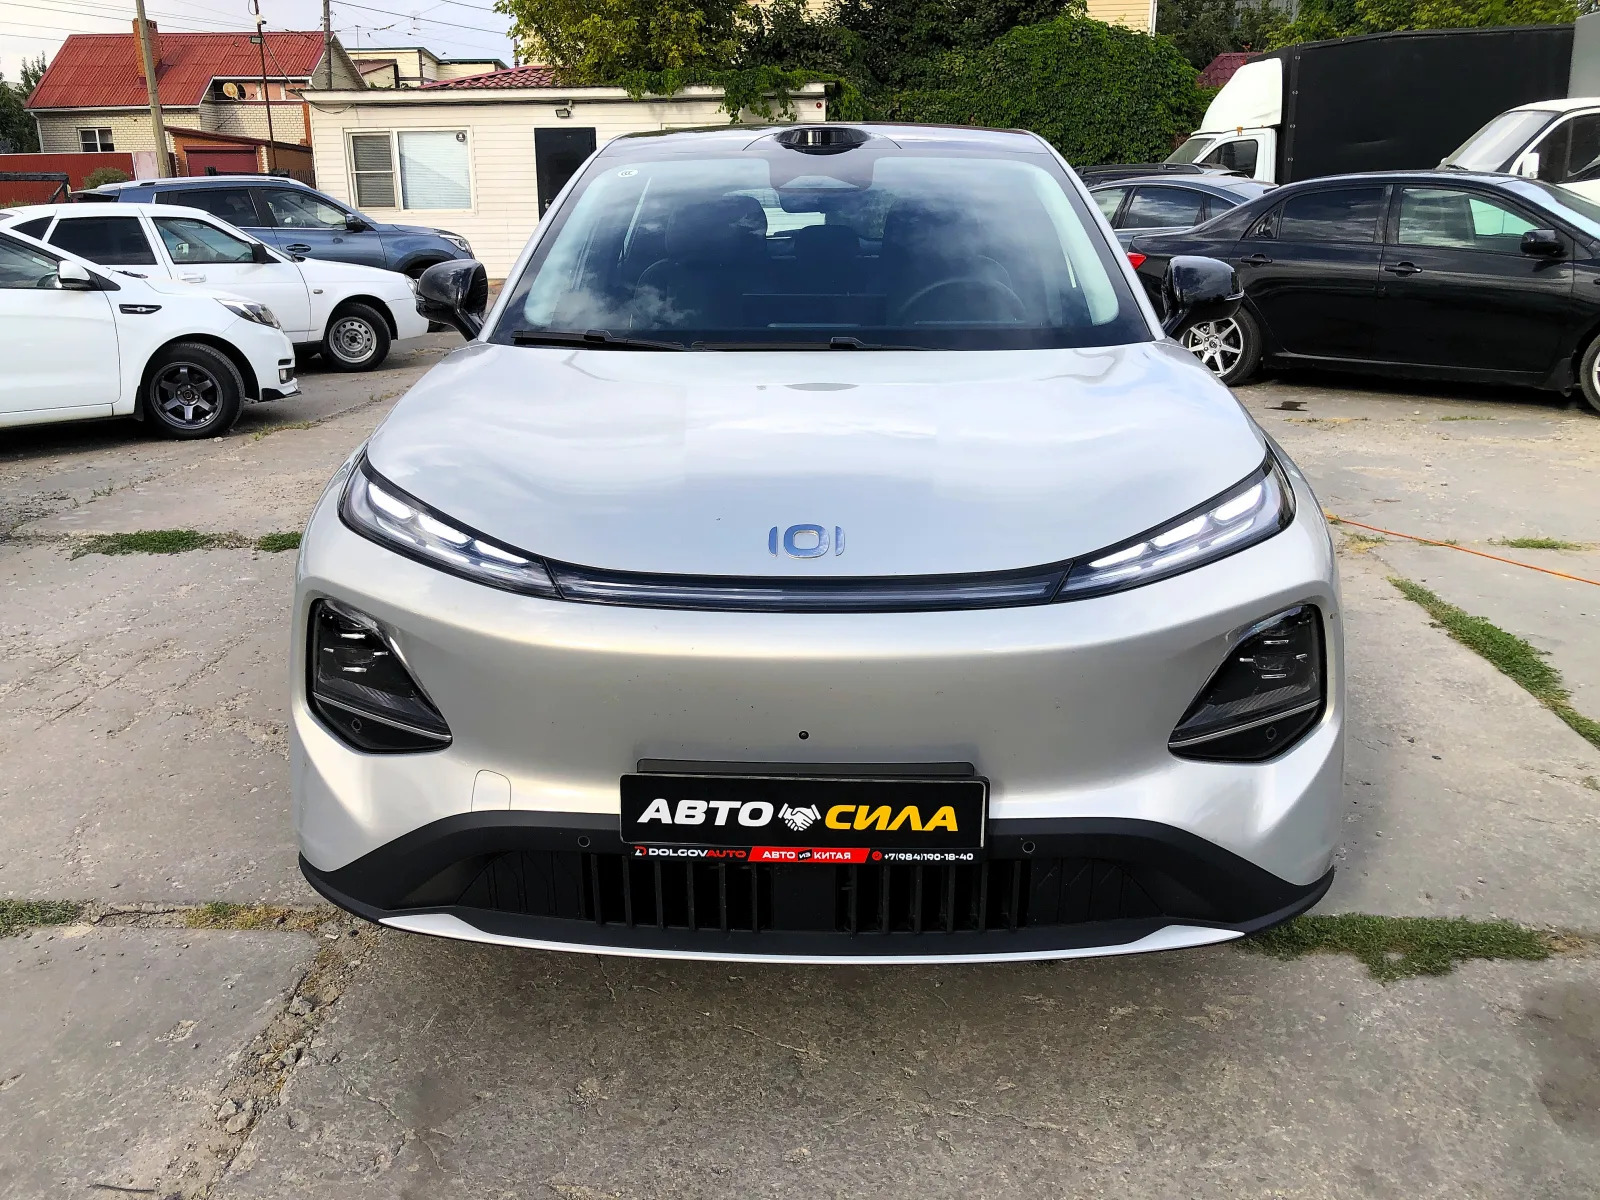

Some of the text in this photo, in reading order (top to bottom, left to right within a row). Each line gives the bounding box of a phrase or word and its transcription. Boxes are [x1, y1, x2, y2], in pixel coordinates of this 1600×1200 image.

[636, 798, 959, 832] АВТО СИЛА
[648, 848, 747, 858] DOLGOVAUTO
[762, 850, 796, 859] АВТО
[813, 851, 852, 860] КИТАЯ
